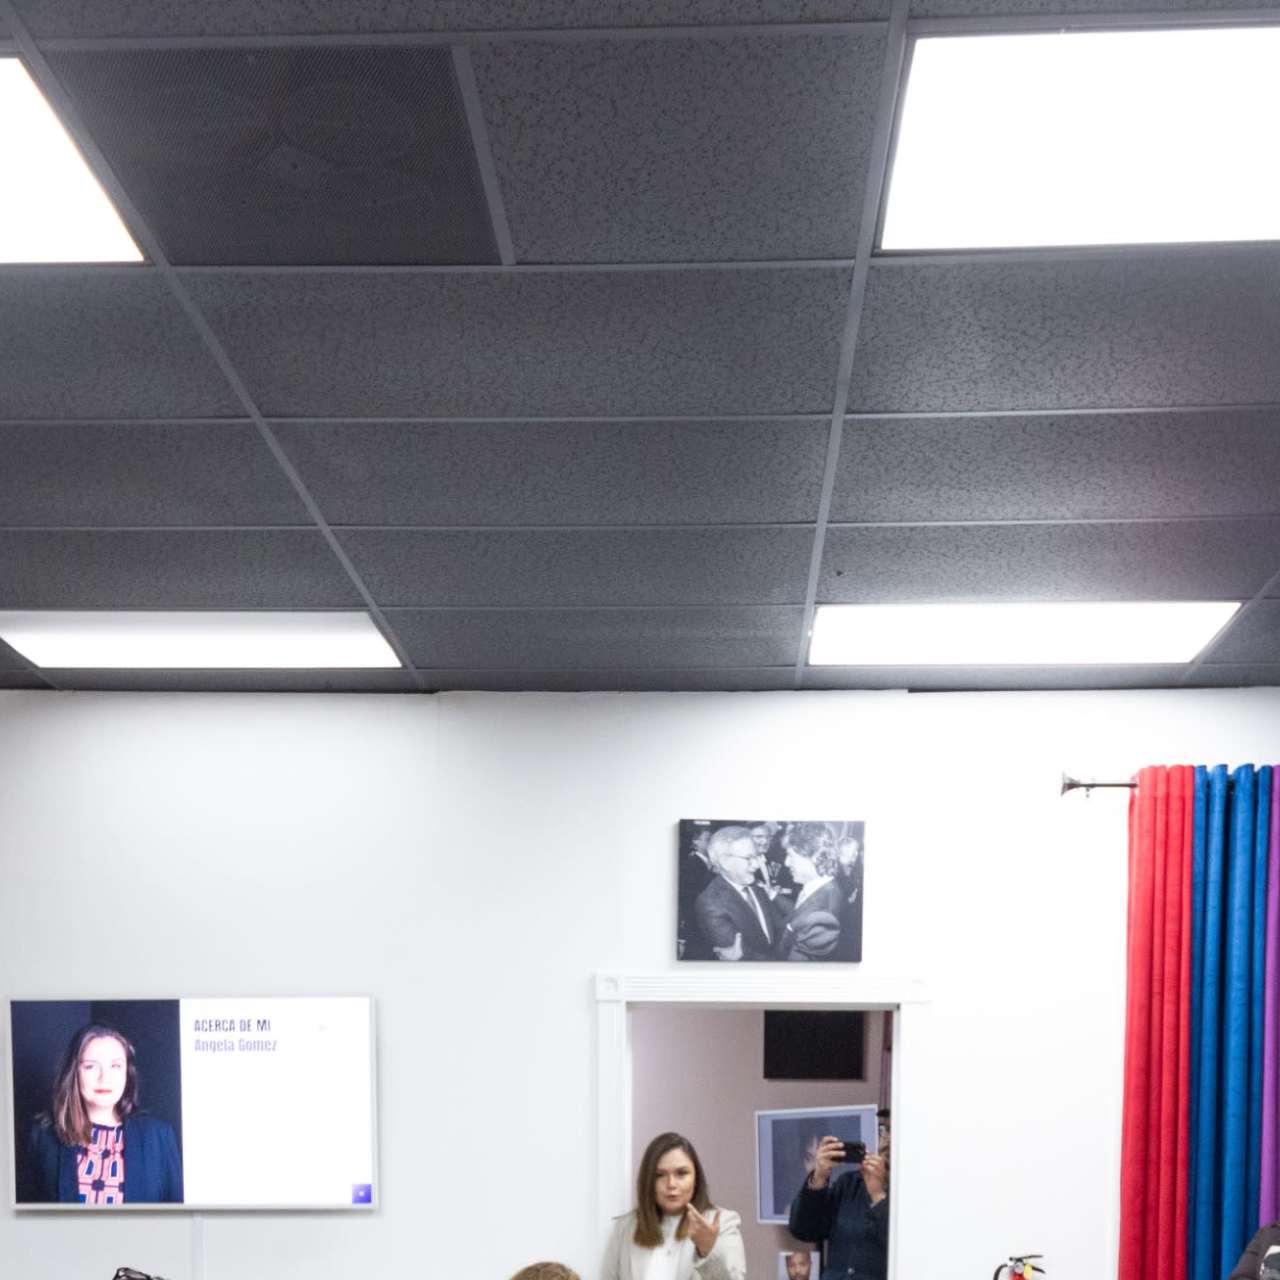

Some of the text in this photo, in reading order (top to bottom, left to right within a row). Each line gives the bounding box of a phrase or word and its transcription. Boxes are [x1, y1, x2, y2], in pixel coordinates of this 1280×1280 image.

[194, 1019, 271, 1032] ACERCA DE MI
[194, 1038, 235, 1053] Angela
